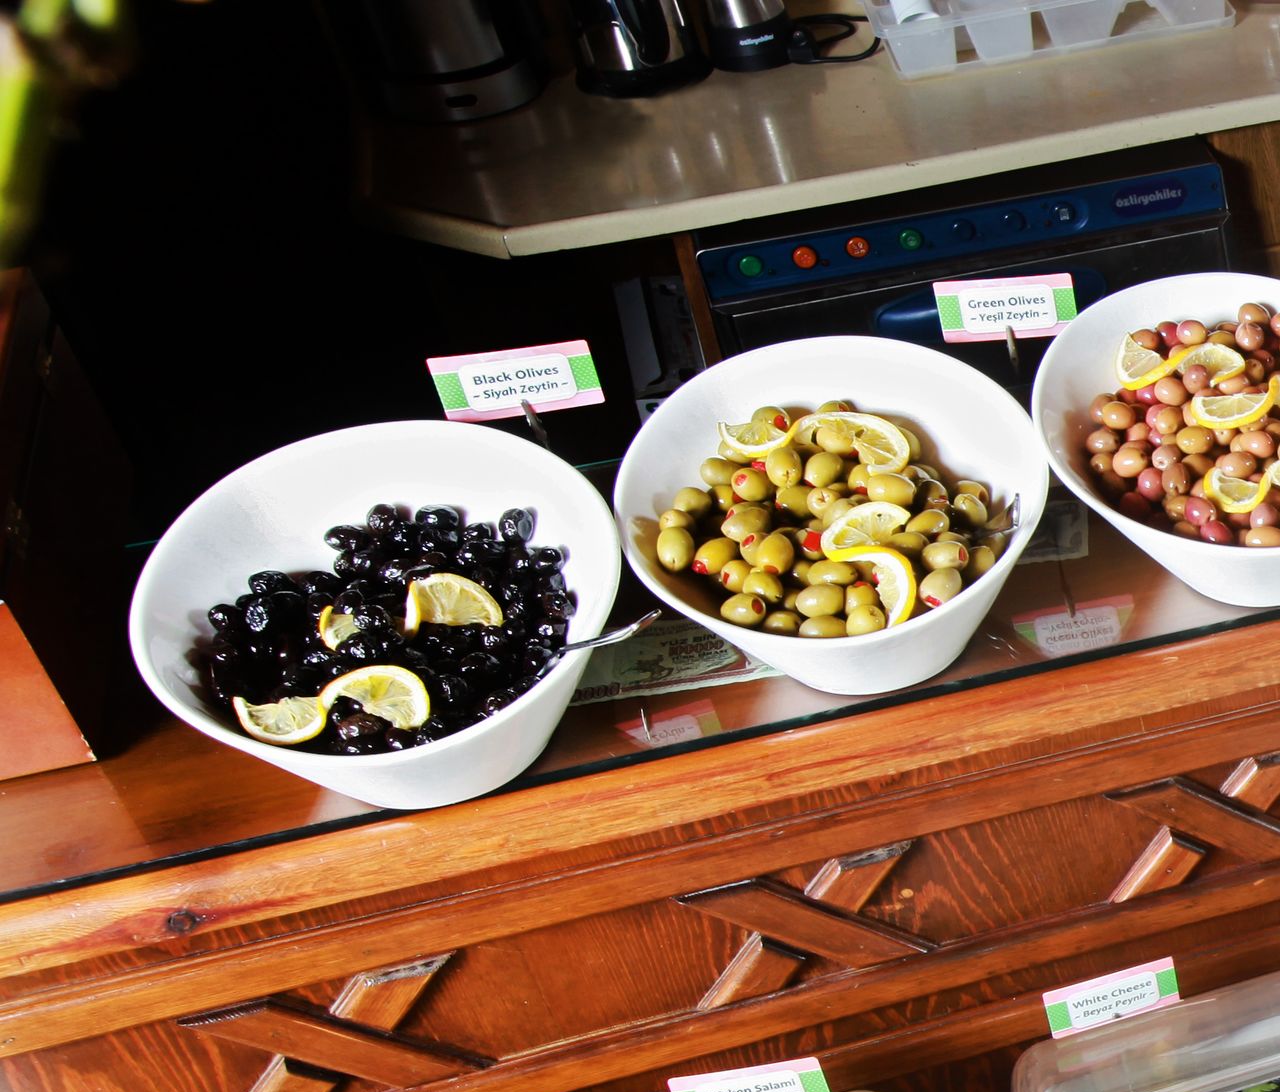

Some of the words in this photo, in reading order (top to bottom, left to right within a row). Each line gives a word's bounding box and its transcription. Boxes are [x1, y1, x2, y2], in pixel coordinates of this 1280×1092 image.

[968, 298, 1006, 310] Green
[1008, 295, 1046, 307] Olives
[979, 311, 1004, 323] Yeşil
[1006, 310, 1039, 322] Zeytin
[473, 370, 512, 386] Black
[515, 365, 559, 381] Olives
[483, 387, 517, 402] Siyah
[519, 380, 559, 397] Zeytin
[1072, 994, 1108, 1009] White
[1111, 980, 1152, 998] Cheese
[1083, 1004, 1113, 1019] Beyaz
[1115, 992, 1147, 1009] Peynir
[755, 1079, 796, 1092] Salami
